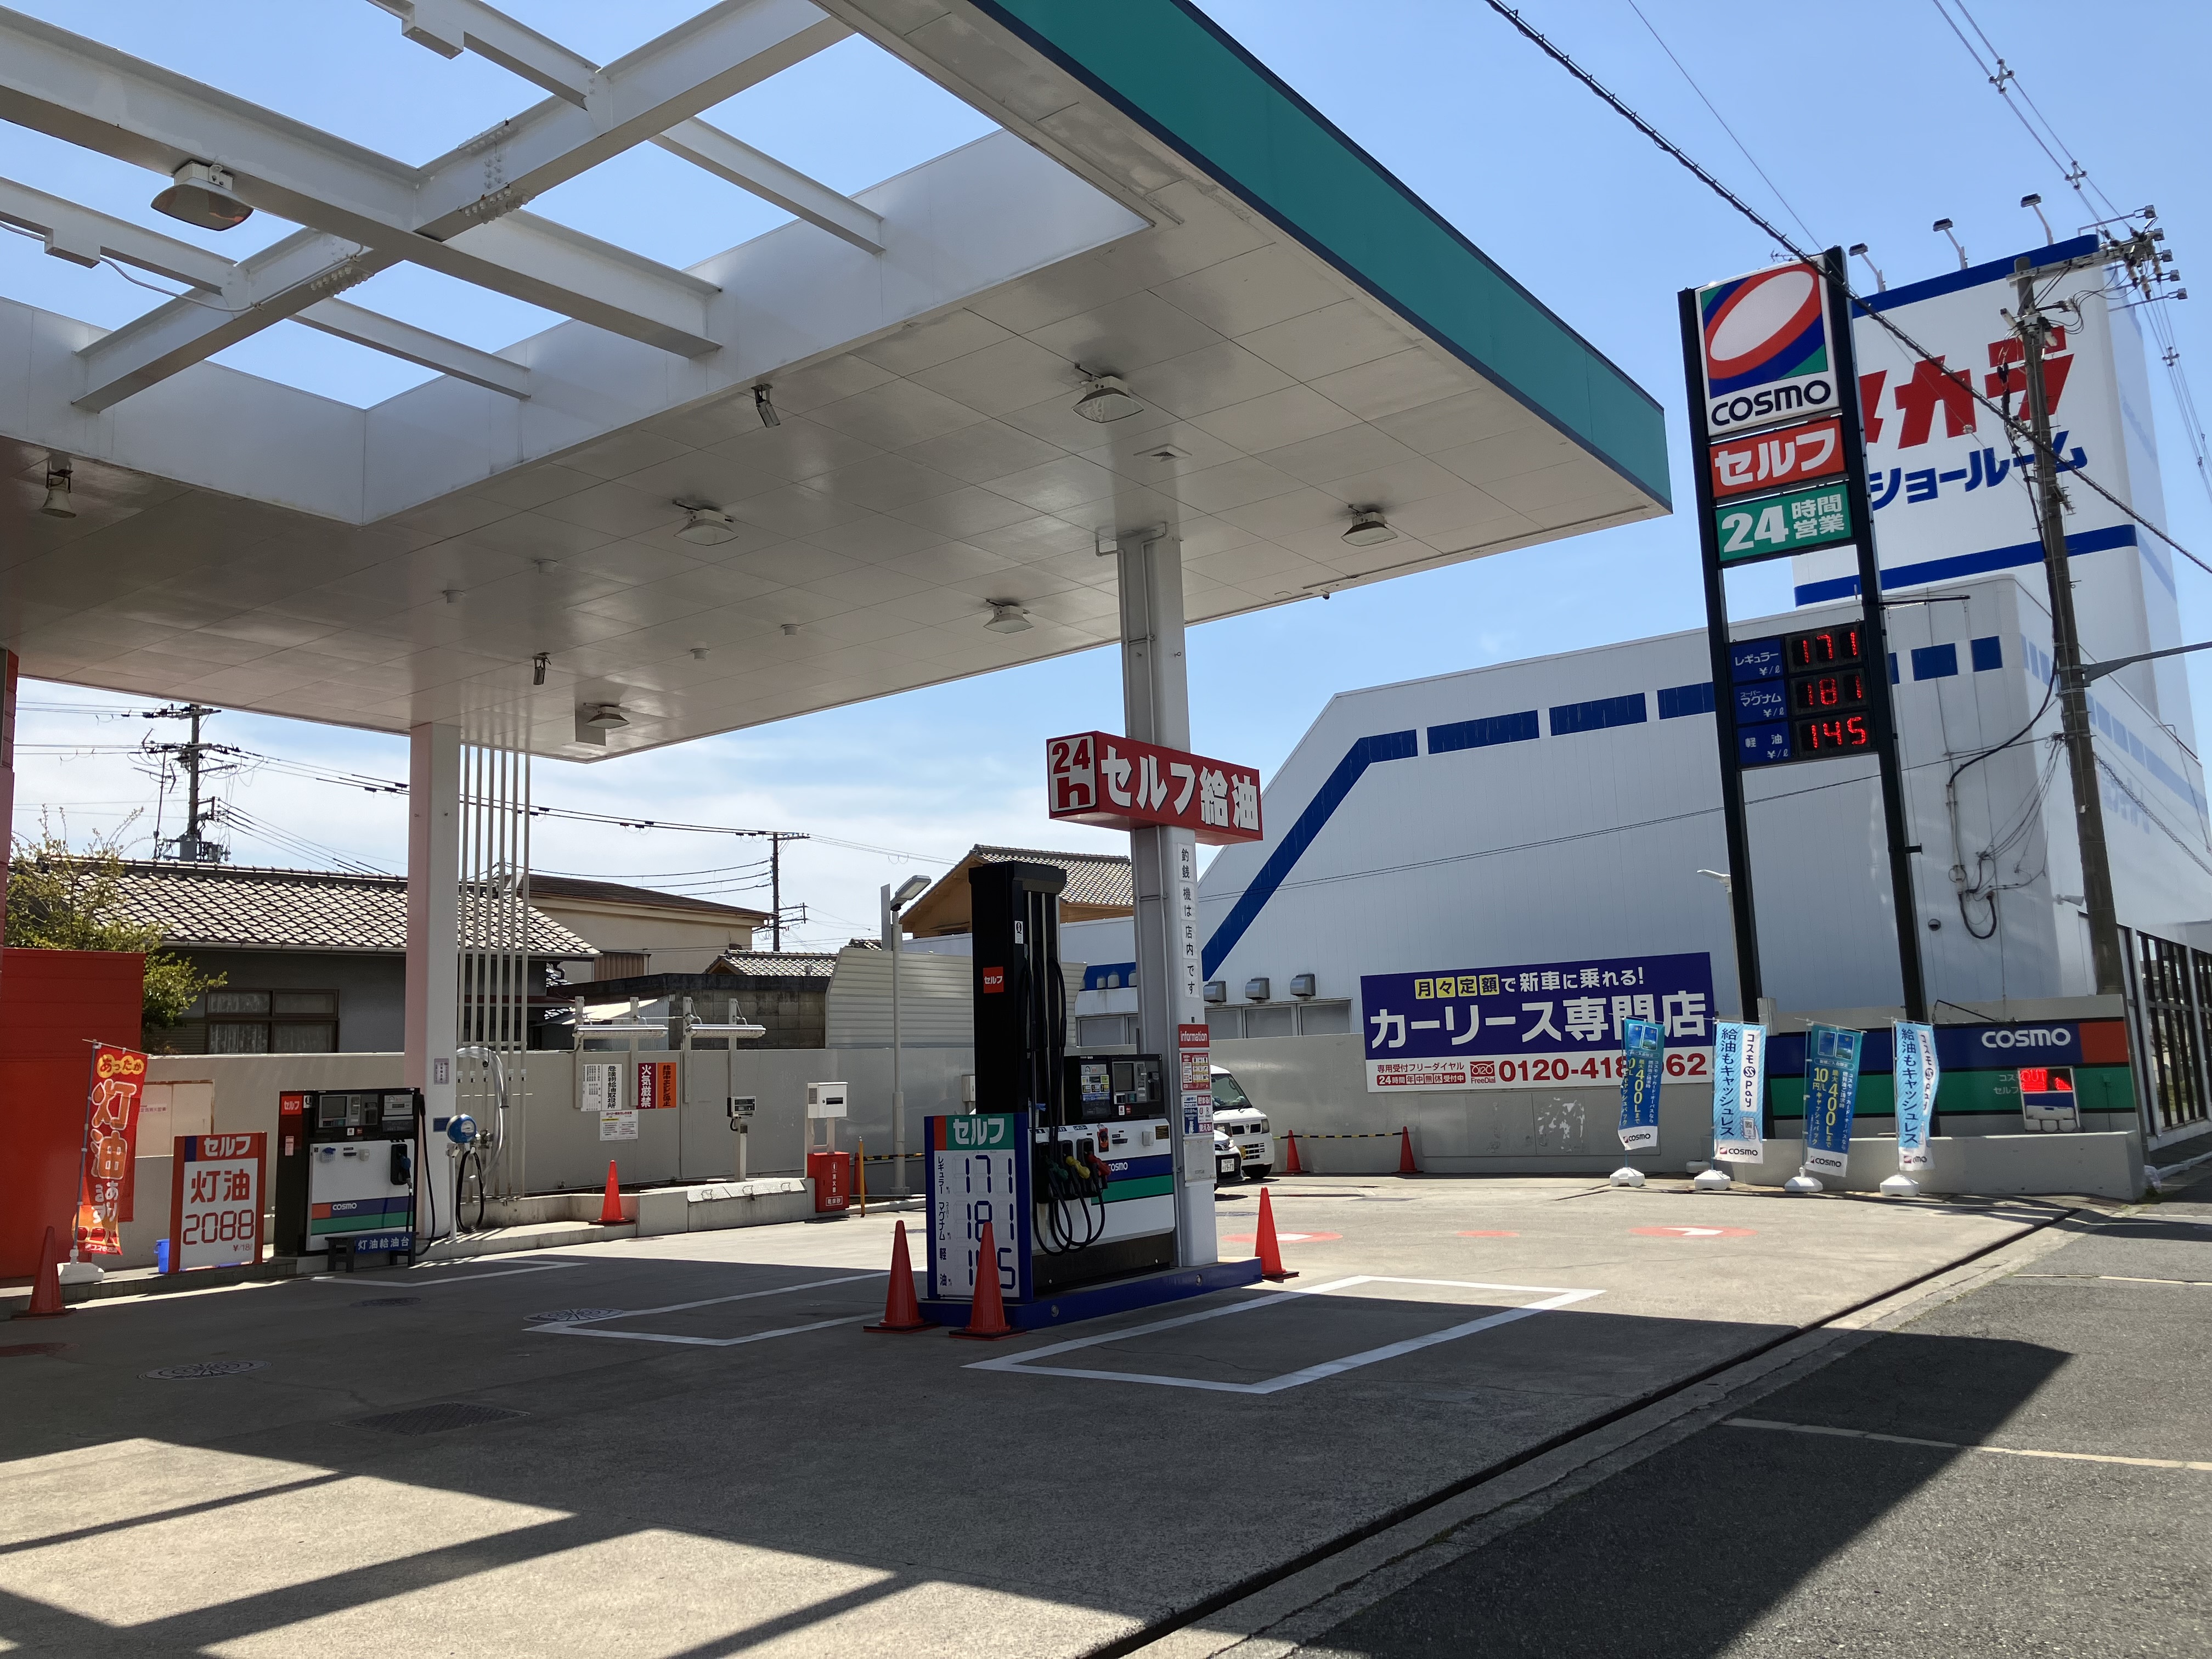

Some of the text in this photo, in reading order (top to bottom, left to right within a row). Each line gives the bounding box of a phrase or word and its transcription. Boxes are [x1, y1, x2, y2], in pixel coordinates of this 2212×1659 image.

[1712, 380, 1831, 426] COSMO
[1714, 428, 1835, 486] セルフ
[1722, 505, 1788, 552] 24
[1793, 514, 1844, 539] 営業
[1735, 632, 1858, 665] レギュラー 171
[1740, 675, 1863, 707] マグナム 181
[1812, 716, 1866, 748] 145
[1052, 738, 1091, 775] 24
[1056, 776, 1090, 809] h
[1101, 744, 1259, 831] セルフ給油
[984, 975, 1003, 984] セルフ
[1180, 1031, 1208, 1041] information
[1370, 991, 1706, 1049] カーリース専門店
[1982, 1028, 2071, 1048] COSMO
[100, 1057, 142, 1073] あったか
[1378, 1062, 1464, 1073] 専用受付フリーダイヤル
[1379, 1074, 1464, 1085] 24時間年中無休受付中
[608, 1065, 616, 1109] 危険物給油取扱所
[641, 1065, 652, 1108] 火気厳禁
[663, 1065, 671, 1107] 給油中エンジン停止
[1719, 1028, 1737, 1136] 給油もキャッシュレス
[1901, 1028, 1918, 1143] 給油もキャッシュレス
[284, 1101, 300, 1110] セルフ
[91, 1079, 137, 1180] 灯油
[953, 1118, 1005, 1146] セルフ
[1629, 1133, 1651, 1142] COSMO
[204, 1136, 251, 1157] セルフ
[1815, 1158, 1842, 1167] COSMO
[965, 1155, 1013, 1194] 171
[1108, 1162, 1128, 1171] OSMO
[191, 1169, 250, 1204] 灯油
[183, 1209, 254, 1245] 2088
[967, 1200, 1015, 1242] 181
[358, 1236, 409, 1250] 灯油給油台
[968, 1248, 1015, 1289] 15
